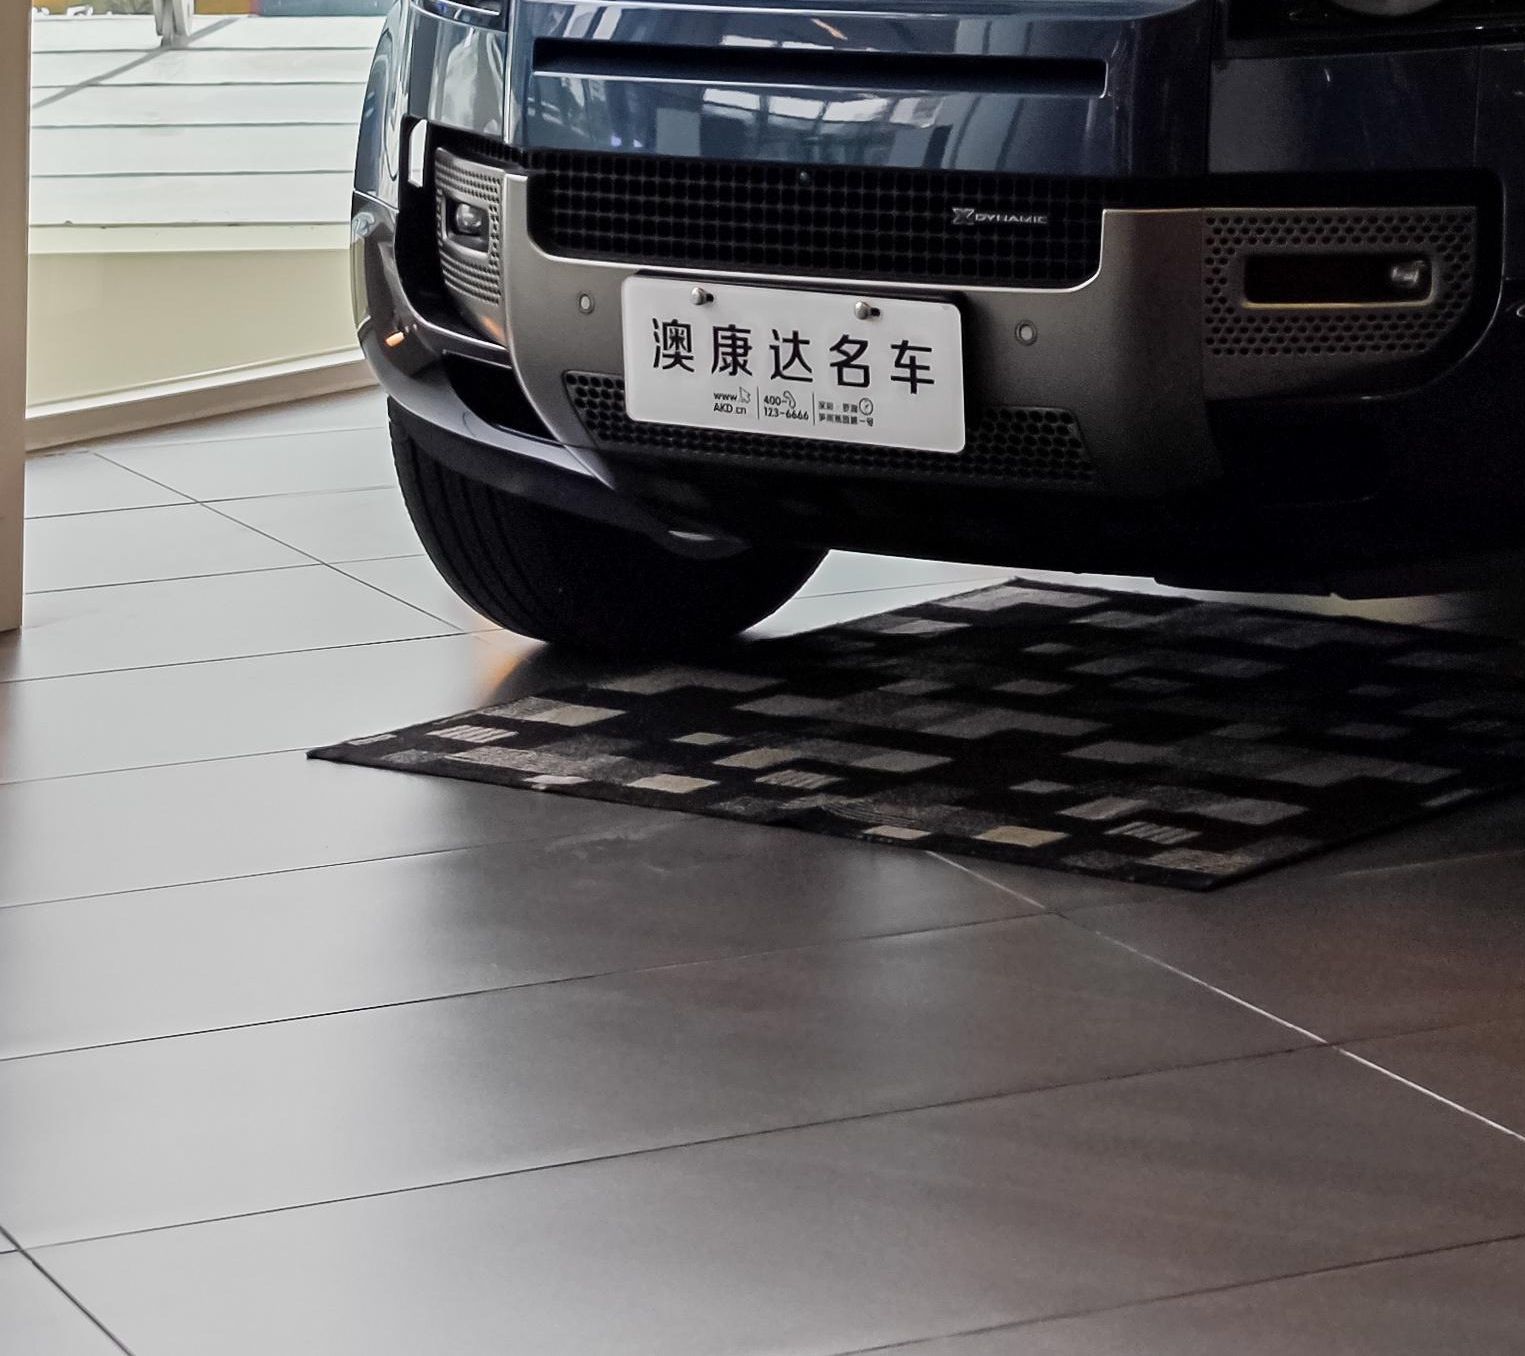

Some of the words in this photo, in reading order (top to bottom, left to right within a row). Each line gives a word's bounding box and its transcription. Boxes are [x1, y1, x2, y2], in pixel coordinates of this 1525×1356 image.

[652, 317, 935, 394] 澳康达名车
